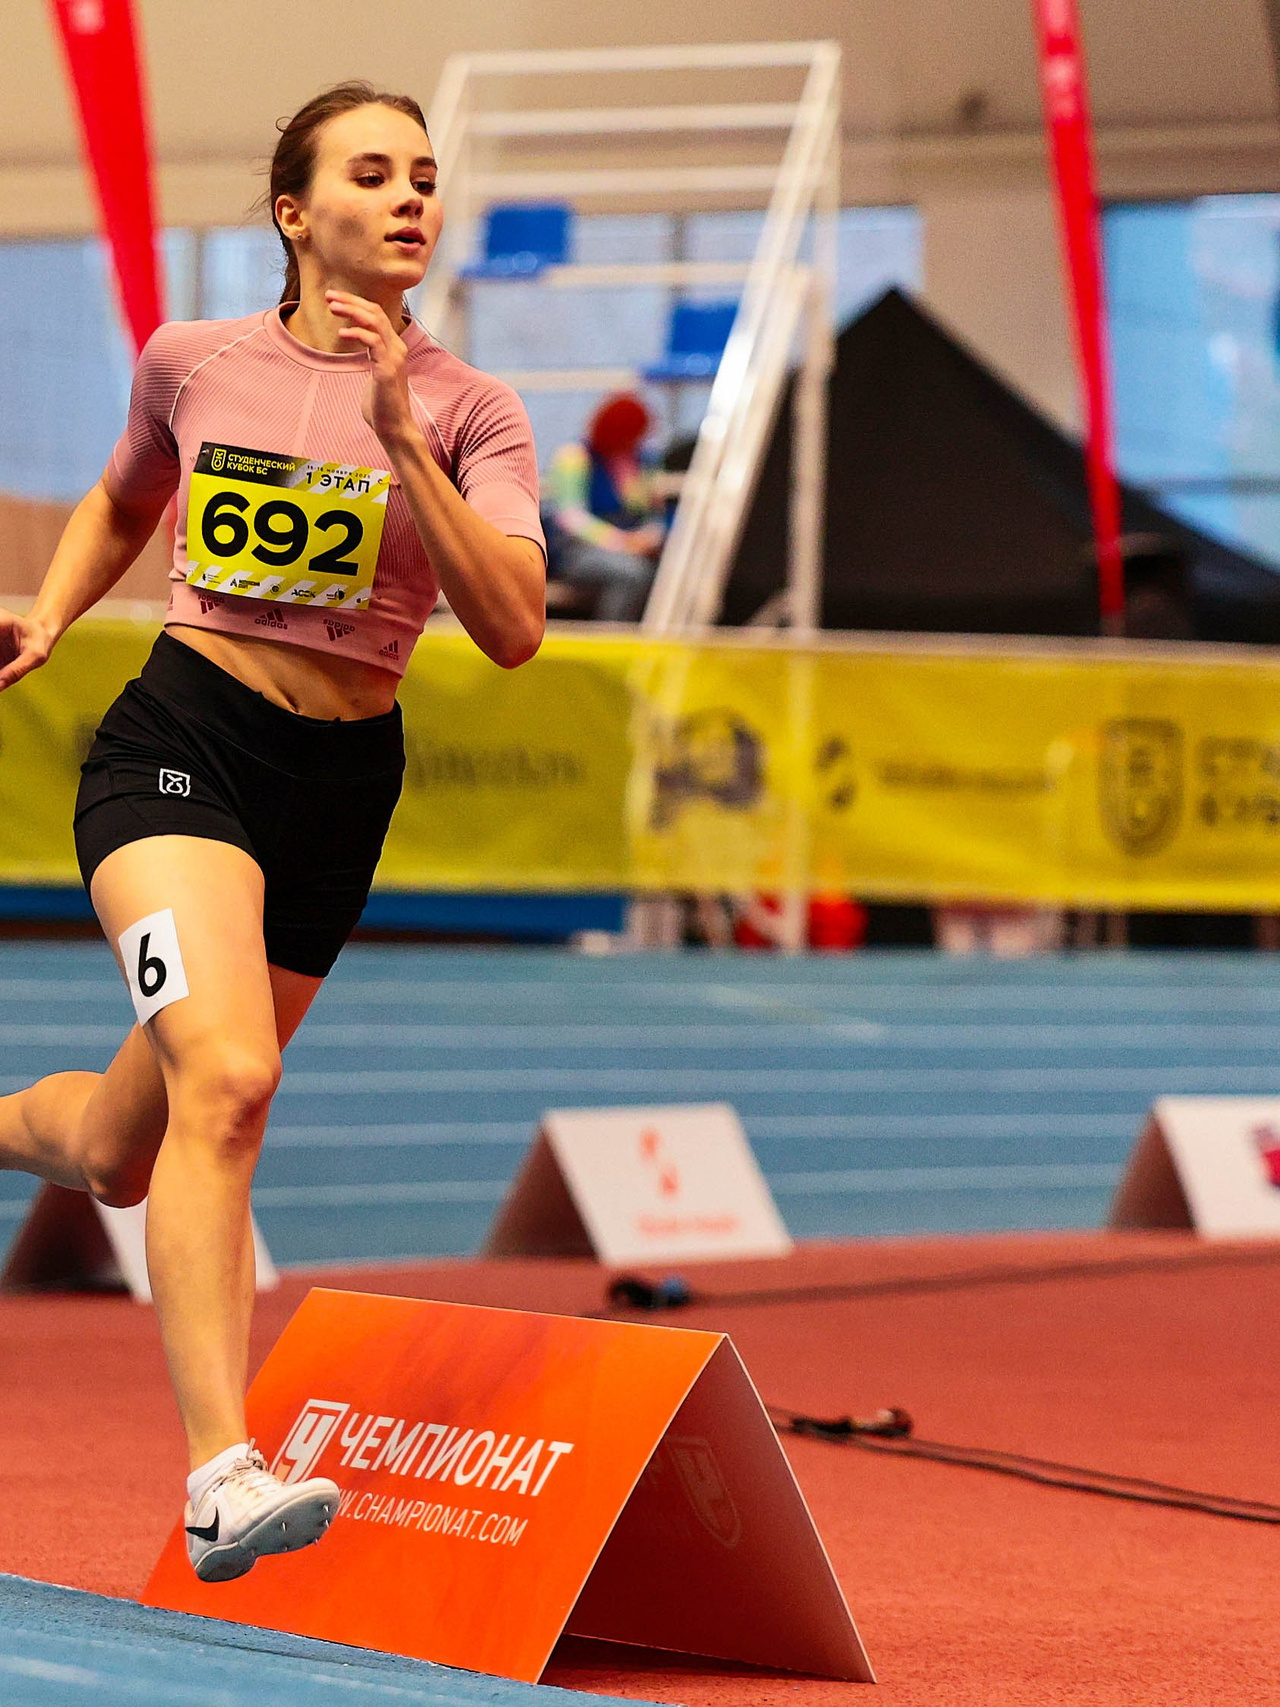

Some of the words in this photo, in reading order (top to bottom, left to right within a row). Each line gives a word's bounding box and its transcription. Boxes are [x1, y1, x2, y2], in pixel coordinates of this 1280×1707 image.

[226, 461, 255, 473] КУБОК
[256, 466, 268, 475] БС
[227, 453, 296, 472] СТУДЕНЧЕСКИЙ
[306, 471, 312, 484] 1
[320, 474, 370, 493] ЭТАП
[201, 491, 364, 577] 692
[254, 617, 288, 630] adidas
[138, 932, 167, 998] 6
[339, 1413, 575, 1497] ЧЕМПИОНАТ
[338, 1487, 529, 1547] W.CHAMPIONAT.COM
